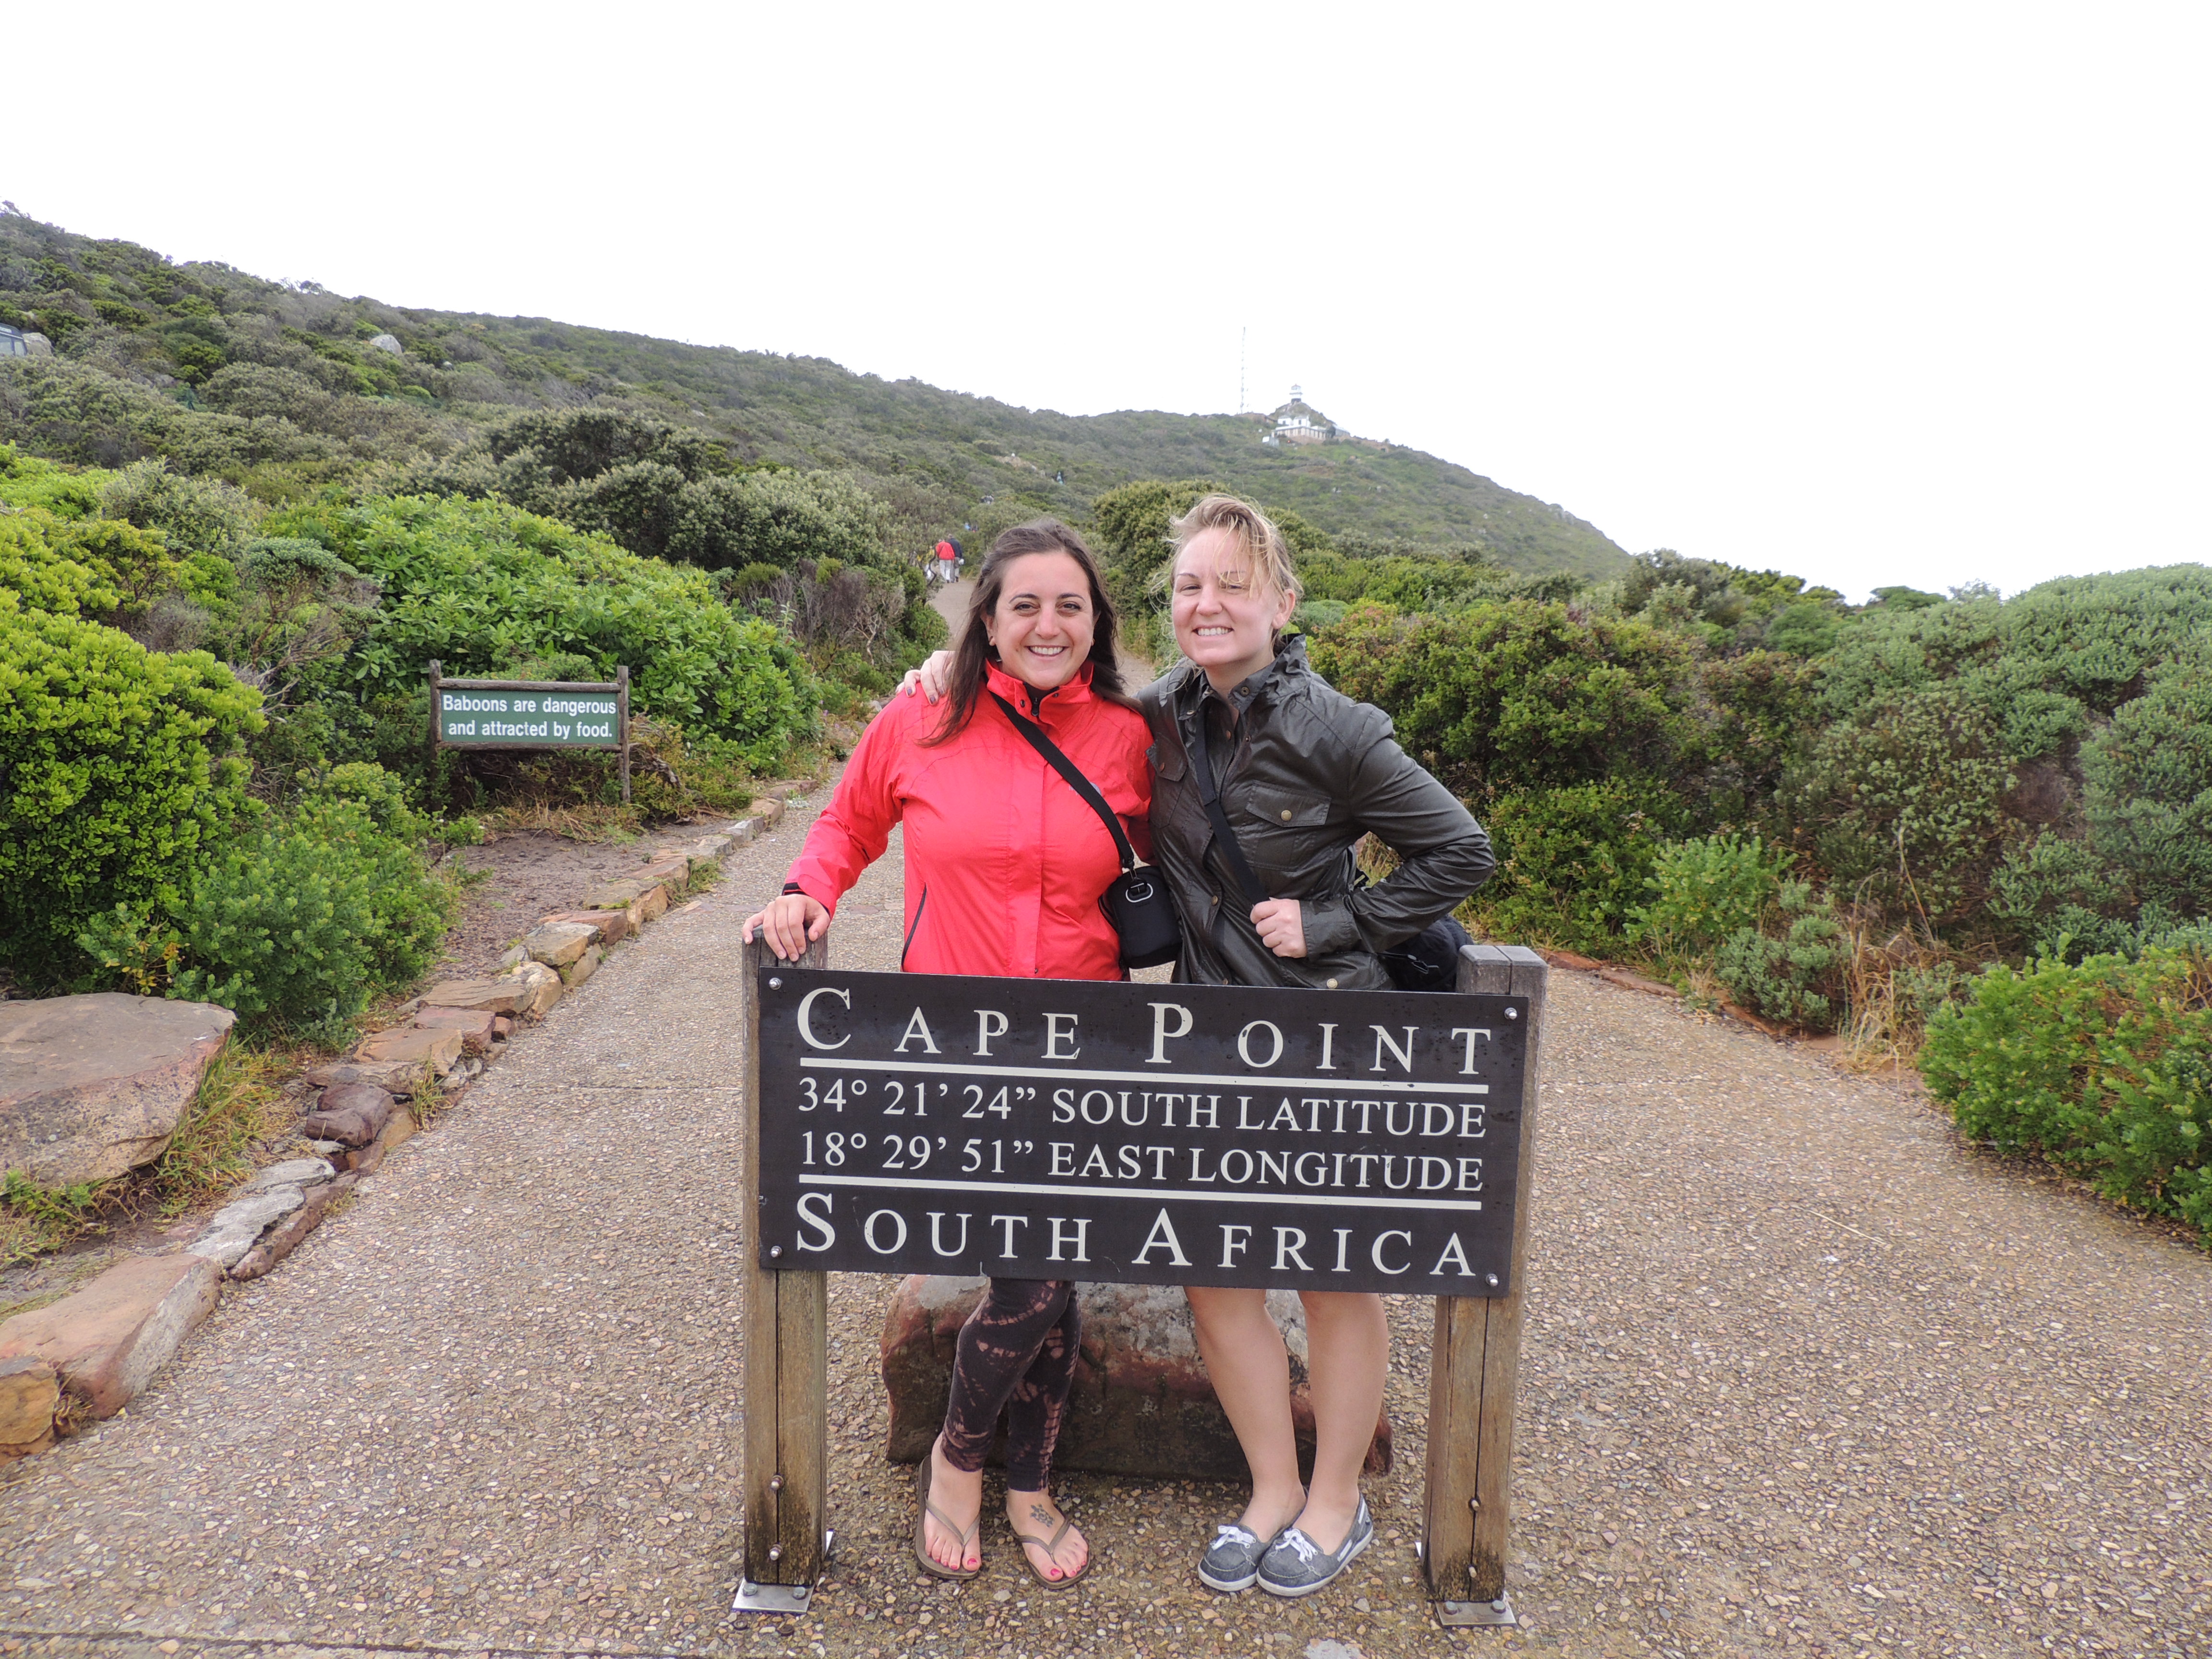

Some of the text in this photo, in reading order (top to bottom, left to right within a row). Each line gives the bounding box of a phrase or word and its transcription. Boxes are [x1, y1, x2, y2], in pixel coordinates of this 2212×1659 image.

[443, 695, 617, 717] Baboons are dangerous
[448, 720, 613, 740] and attracted by food.
[796, 987, 1491, 1074] CAPE POINT
[1052, 1089, 1222, 1128] SOUTH
[1235, 1096, 1486, 1138] LATITUDE
[1047, 1142, 1174, 1180] EAST
[1188, 1148, 1483, 1191] LONGITUDE
[797, 1192, 1476, 1276] SOUTH AFRICA
